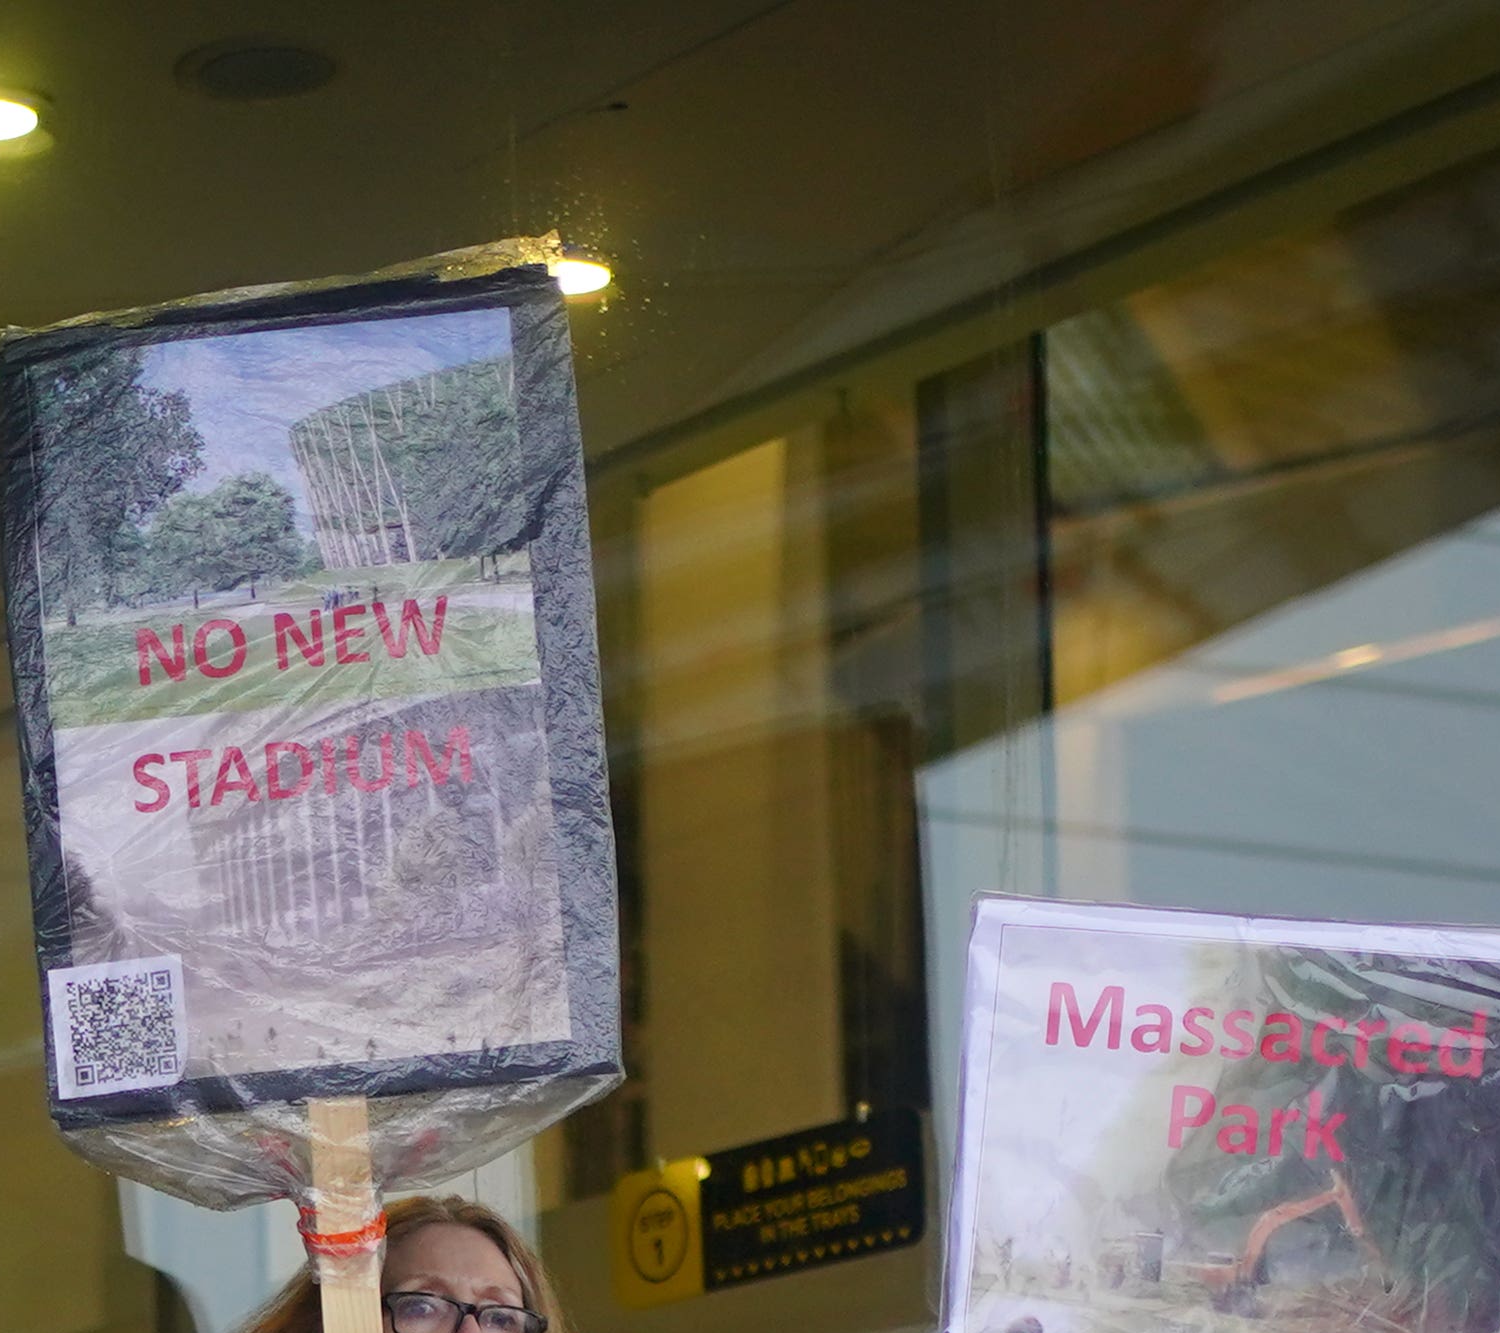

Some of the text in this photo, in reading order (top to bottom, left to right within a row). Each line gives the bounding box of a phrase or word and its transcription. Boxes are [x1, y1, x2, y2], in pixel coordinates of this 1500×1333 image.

[135, 595, 448, 686] NO NEW
[133, 726, 474, 813] STADIUM
[1043, 981, 1490, 1079] Massacred
[1167, 1084, 1349, 1162] Park
[713, 1202, 761, 1231] PLACE
